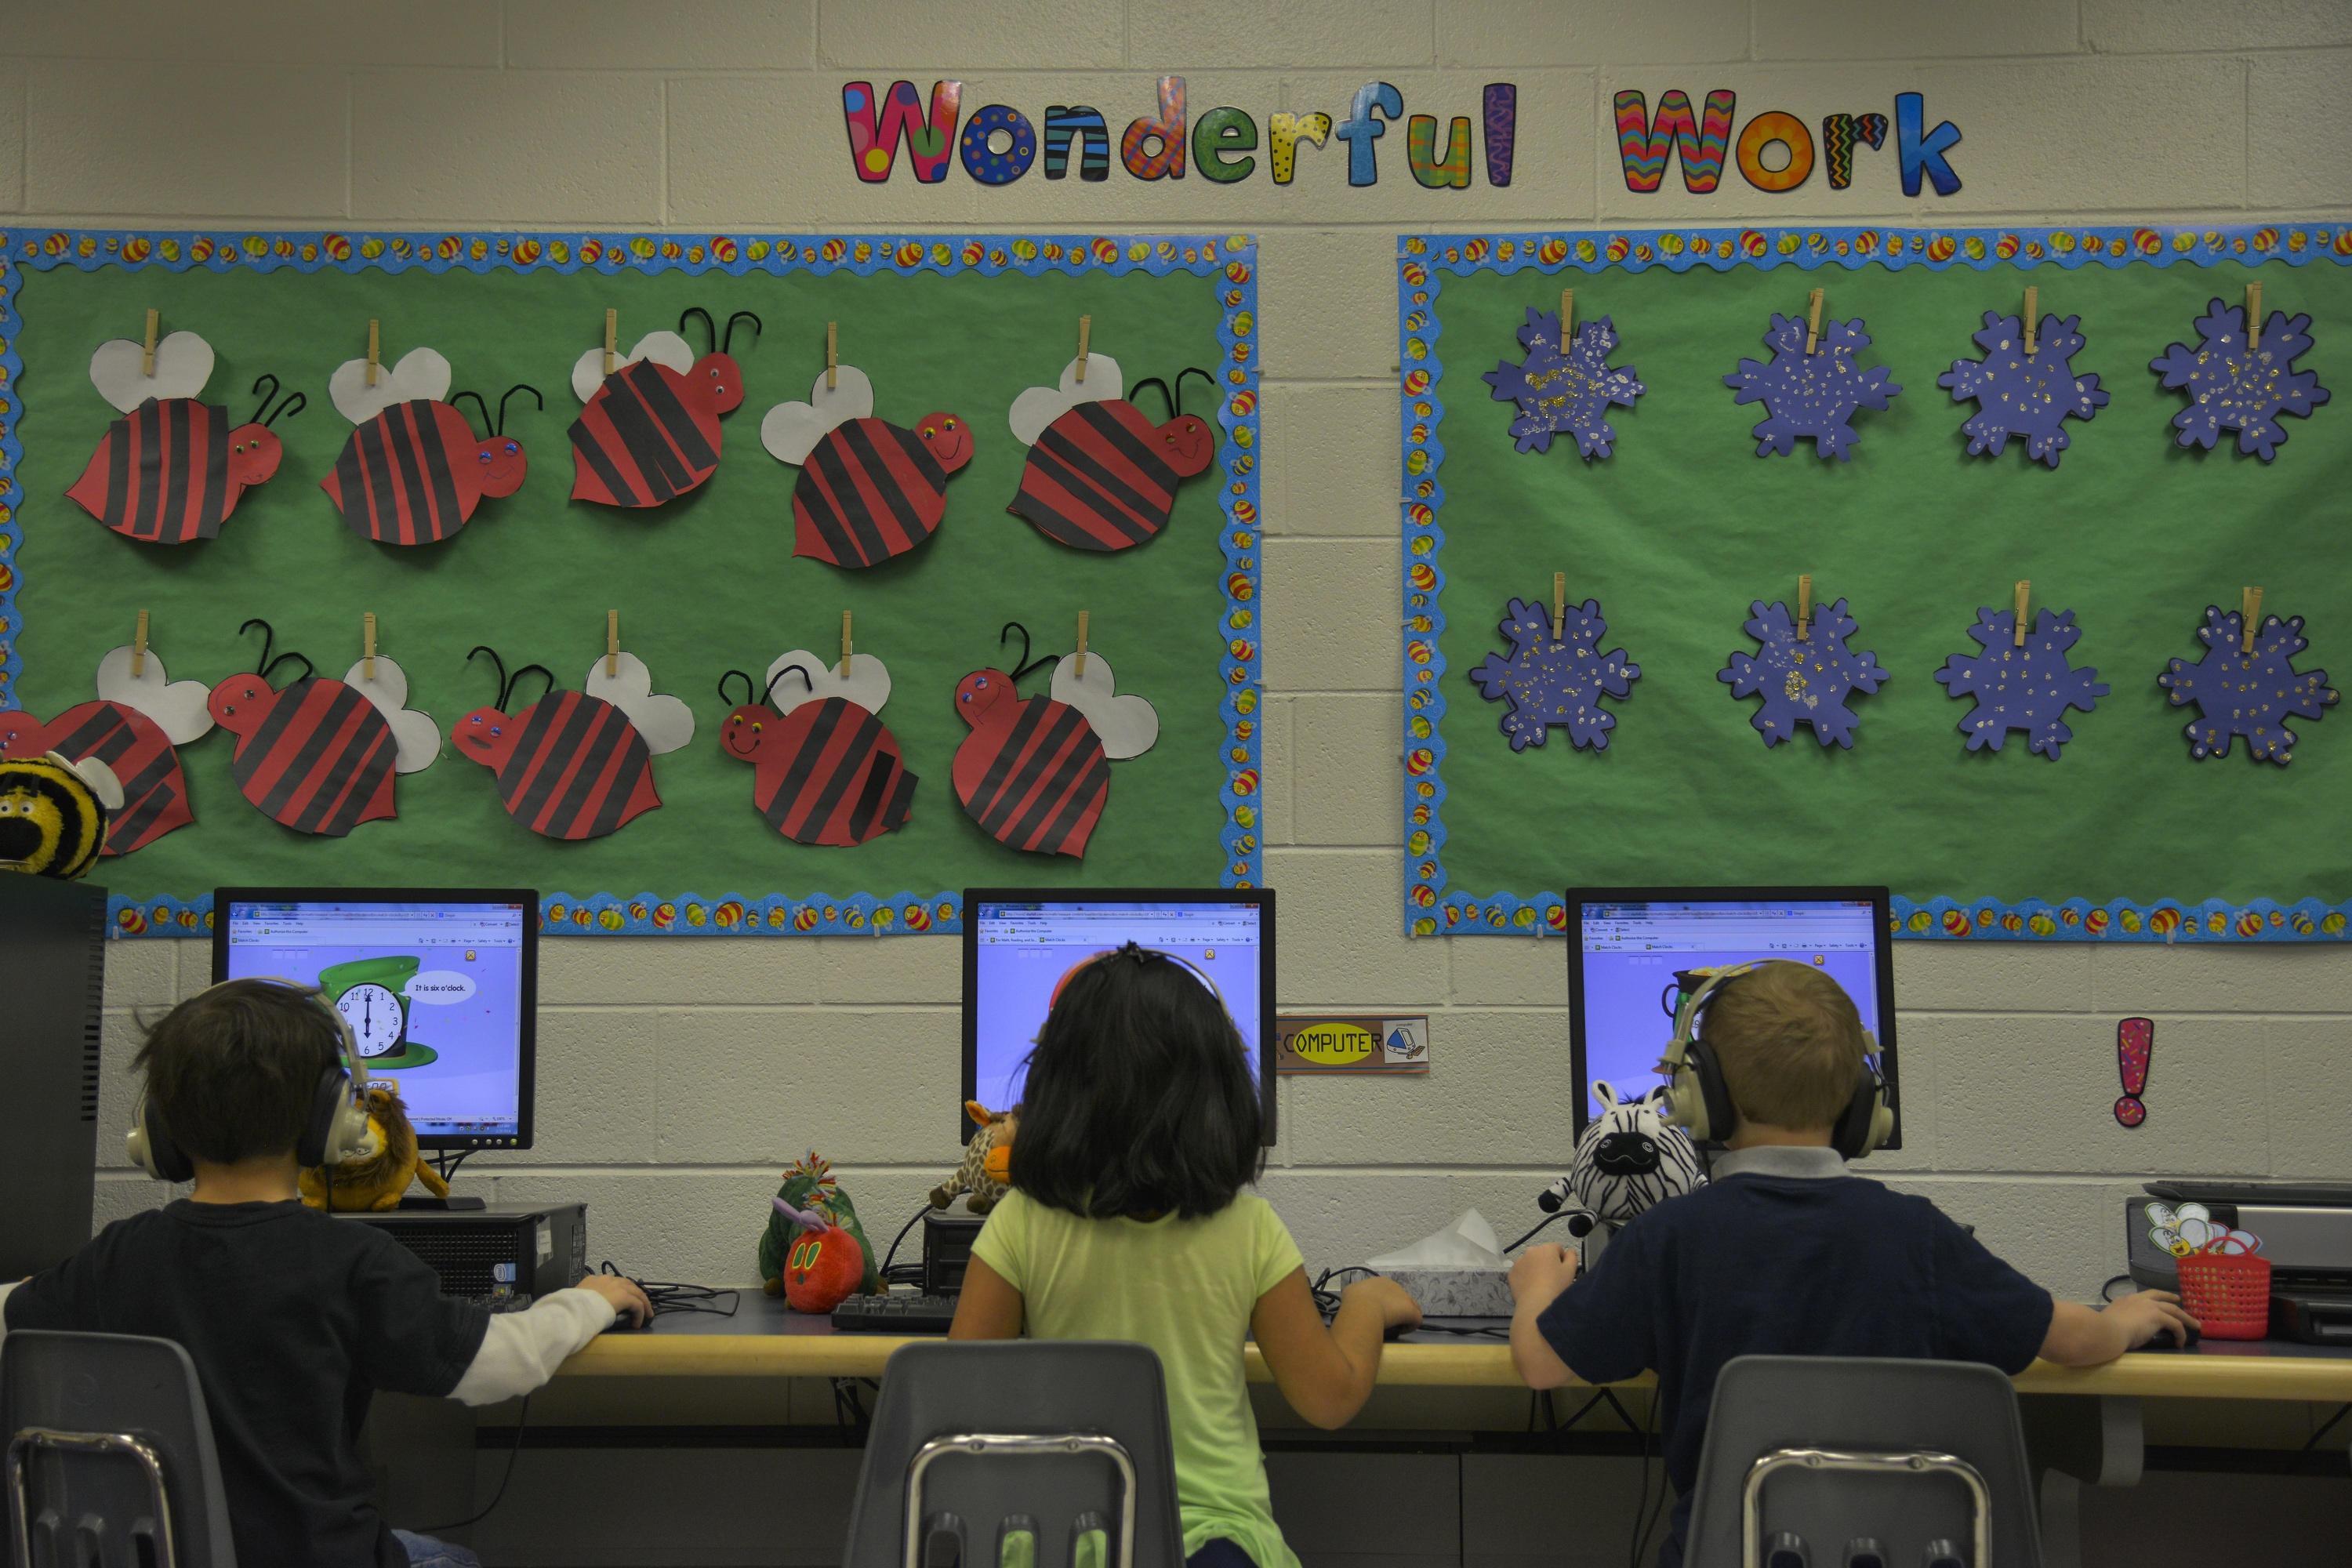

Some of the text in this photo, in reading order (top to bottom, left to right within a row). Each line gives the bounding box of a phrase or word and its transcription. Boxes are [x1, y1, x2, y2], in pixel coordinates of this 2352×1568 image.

[843, 76, 1963, 196] Wonderful Work
[364, 988, 373, 997] 12
[339, 1002, 350, 1011] 10
[390, 1003, 395, 1011] 2
[393, 1017, 398, 1025] 3
[378, 1042, 384, 1051] 5
[1283, 1033, 1382, 1053] COMPUTER
[364, 1046, 370, 1054] 6
